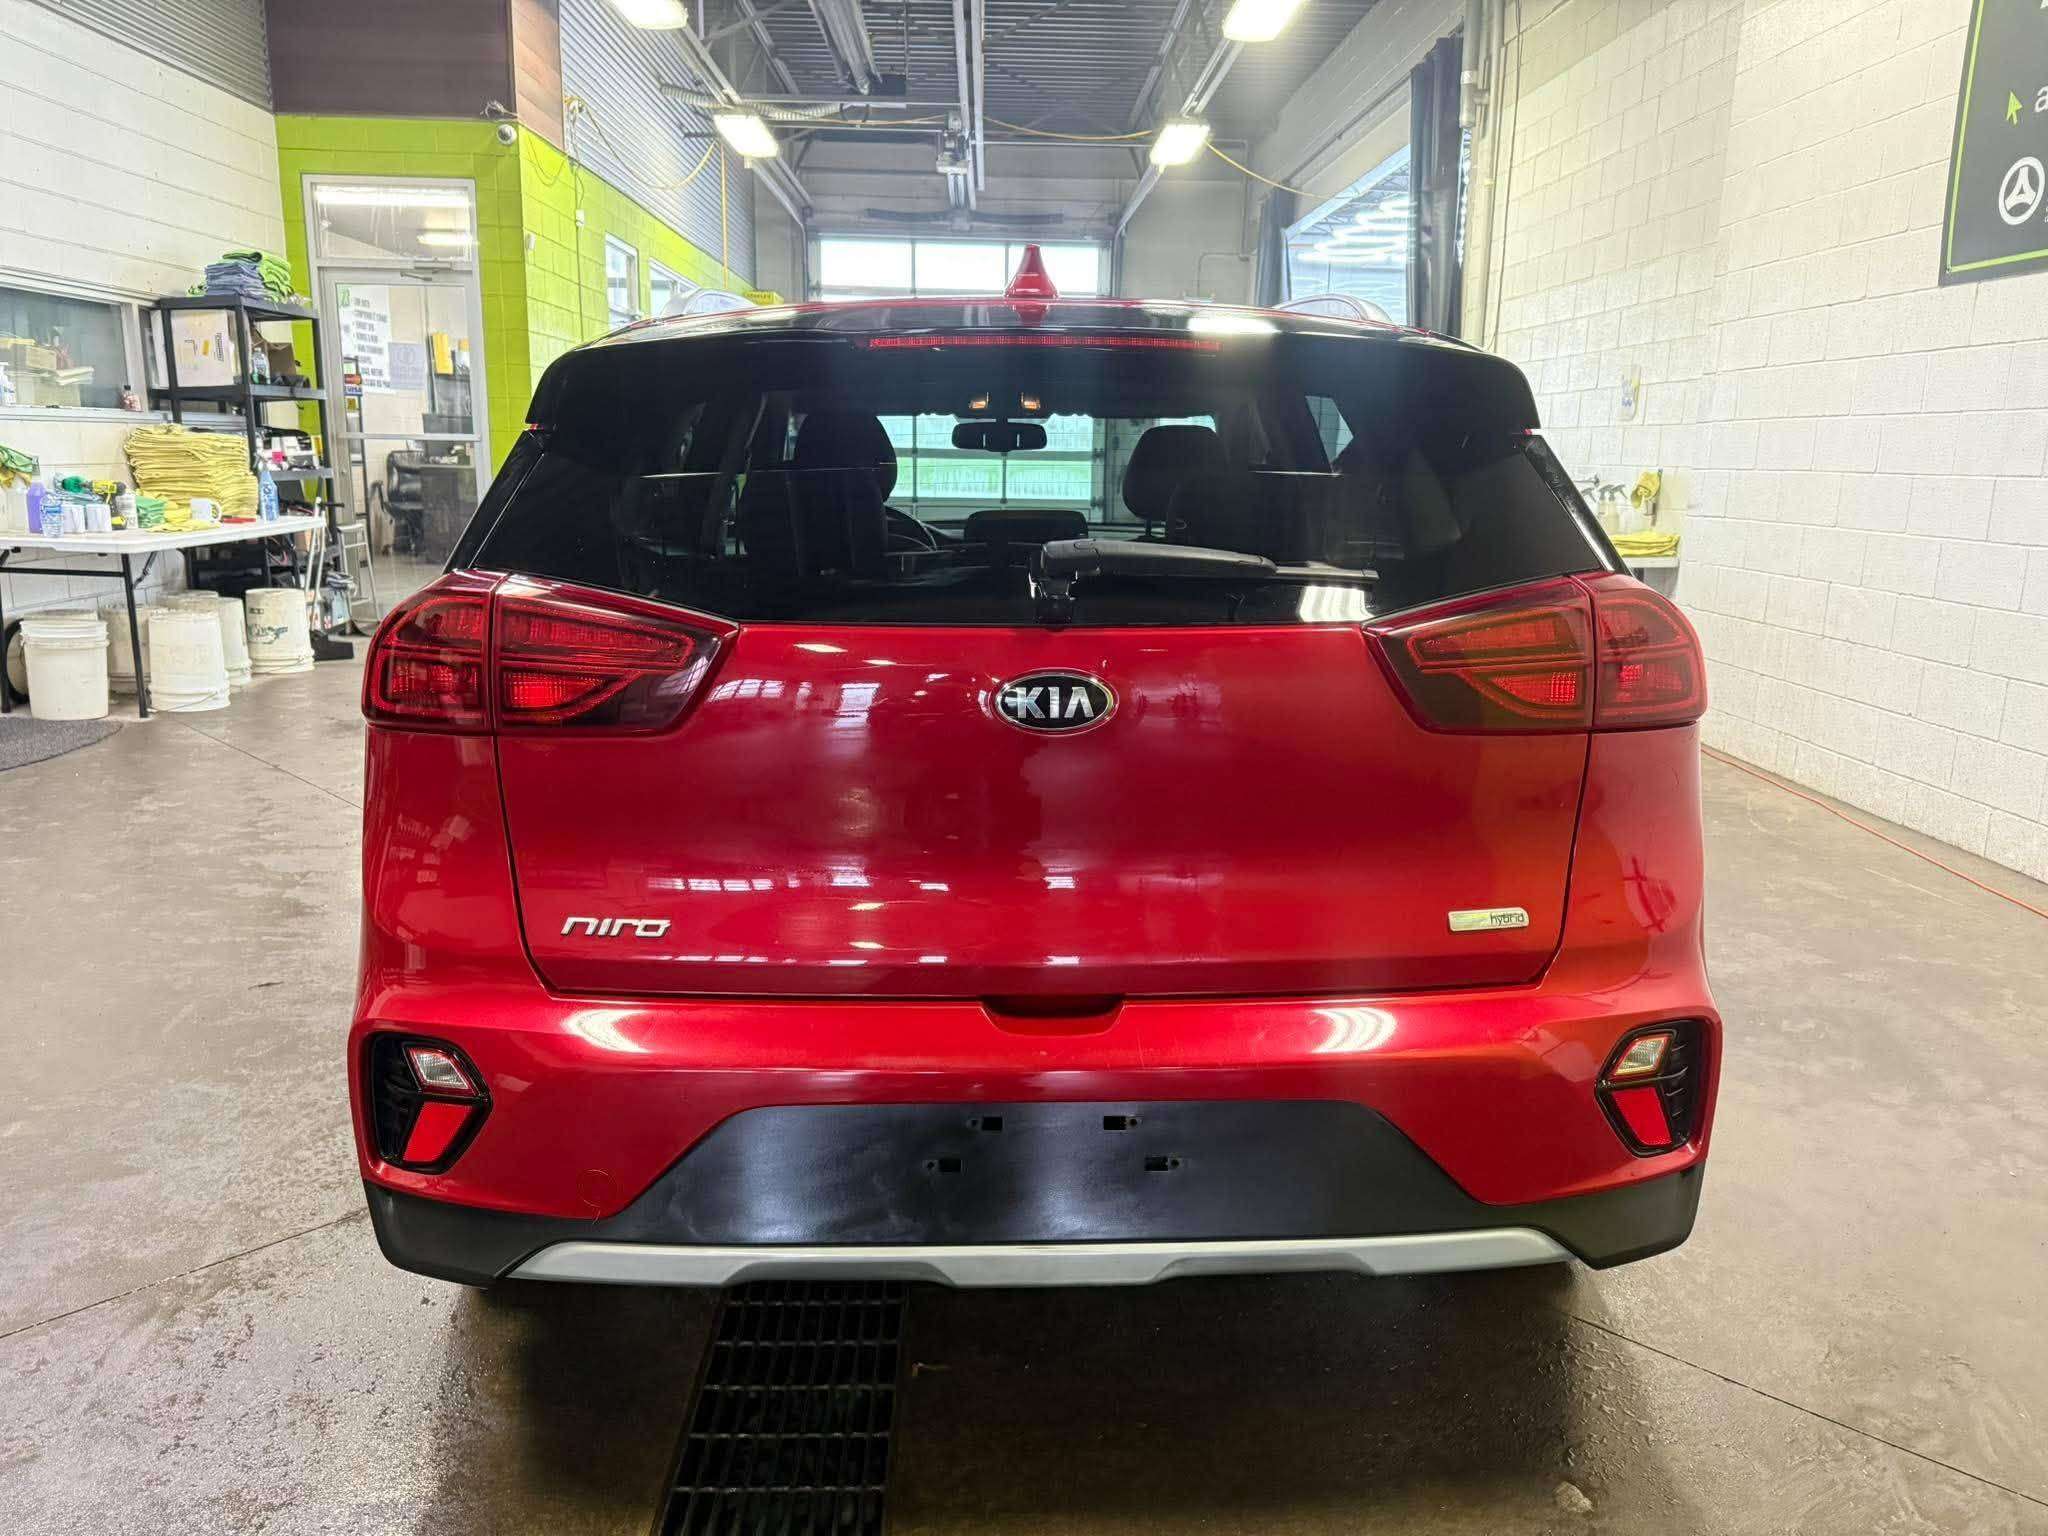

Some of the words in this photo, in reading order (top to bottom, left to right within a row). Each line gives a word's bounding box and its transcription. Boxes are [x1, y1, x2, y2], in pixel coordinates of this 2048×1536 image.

[1015, 686, 1095, 719] KIA
[560, 916, 671, 937] niro
[1490, 911, 1526, 926] hybrid
